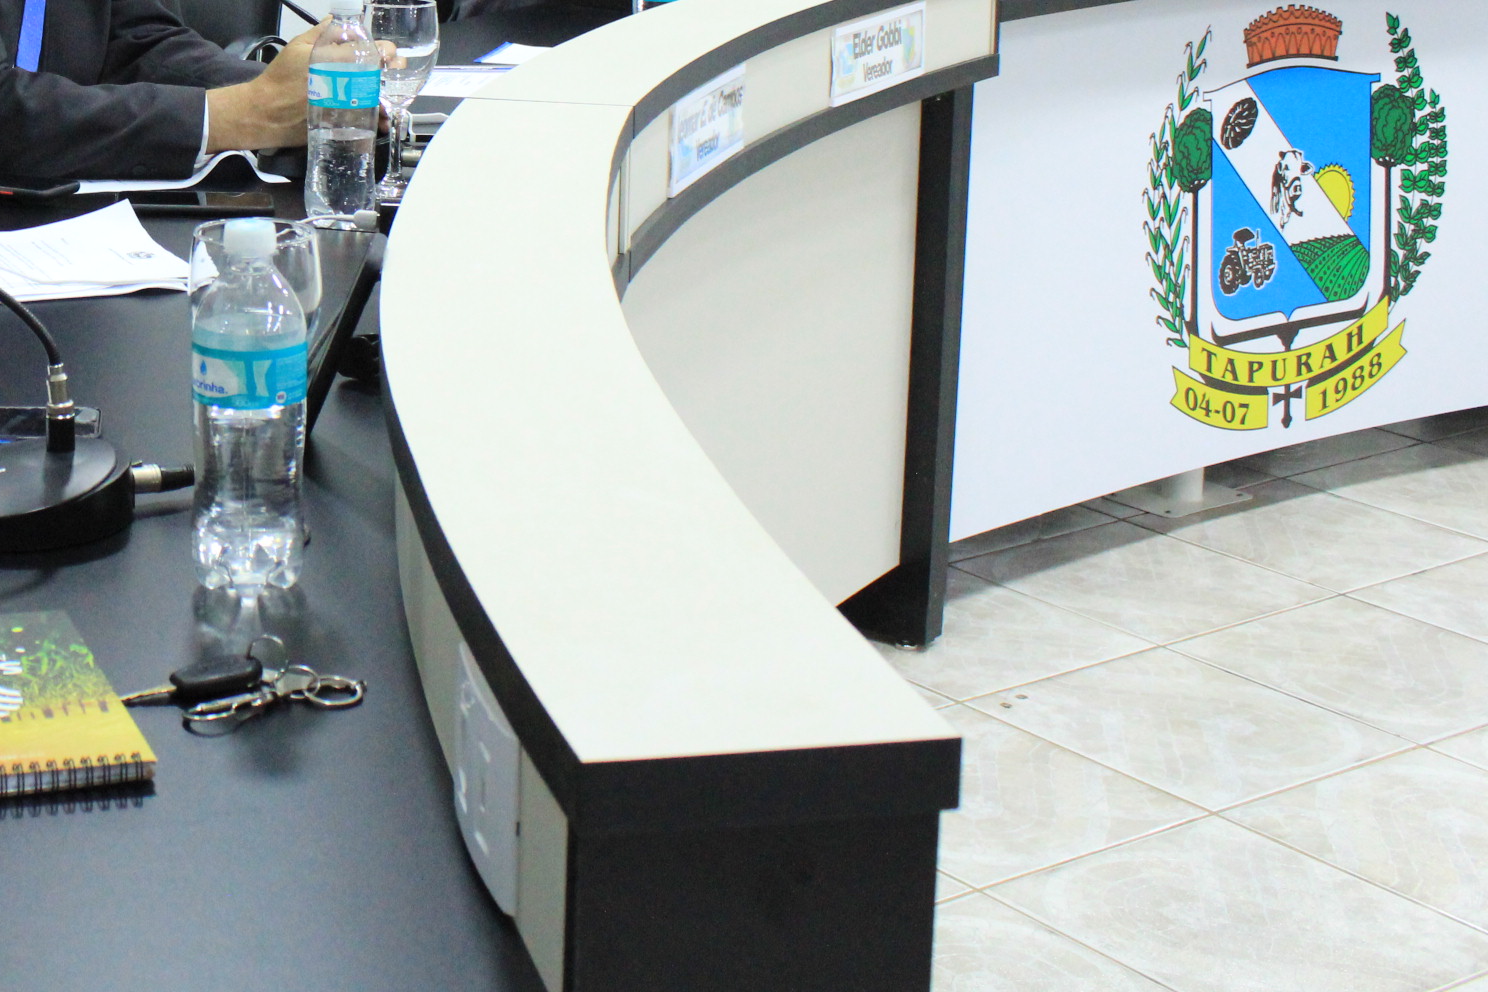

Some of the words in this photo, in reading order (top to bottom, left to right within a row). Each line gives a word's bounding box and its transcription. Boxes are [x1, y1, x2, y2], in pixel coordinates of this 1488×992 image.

[852, 30, 876, 60] Elder
[876, 19, 902, 51] Gobbi
[862, 56, 893, 83] Vereador
[1201, 323, 1367, 385] TAPURAH
[1183, 385, 1252, 426] 04-07
[1318, 350, 1384, 412] 1988
